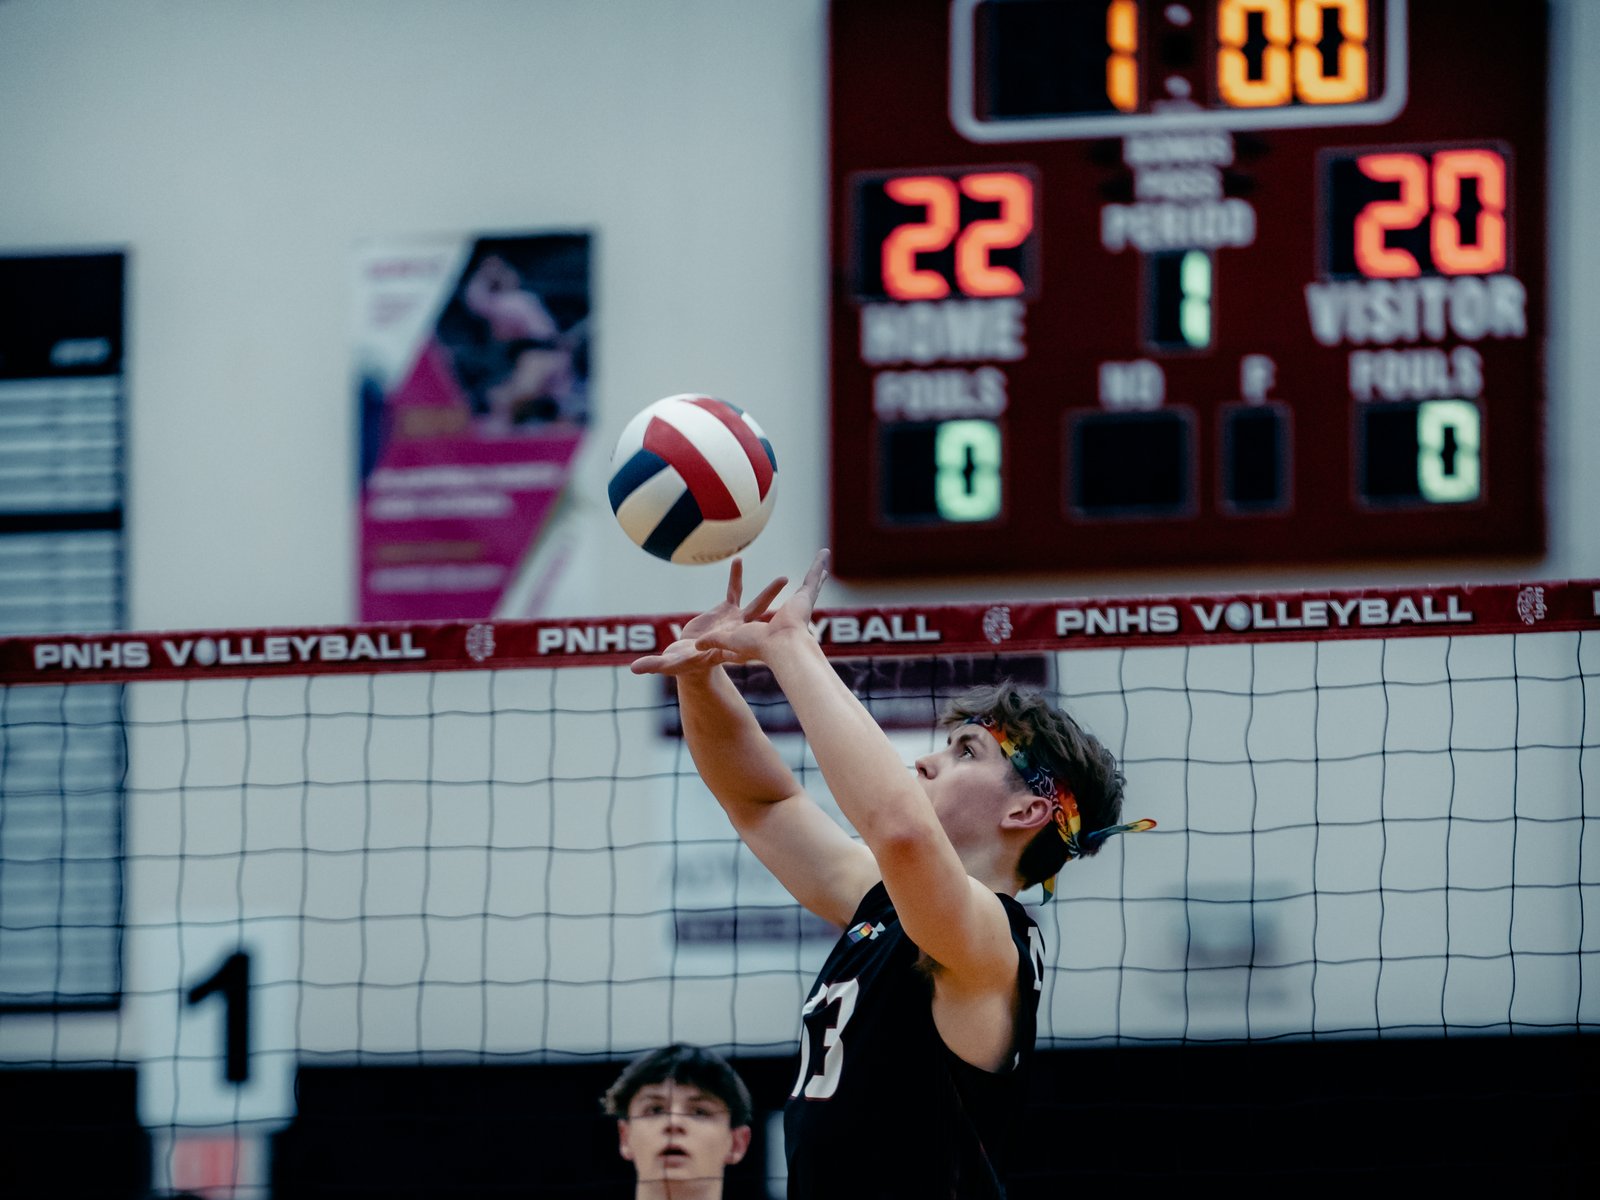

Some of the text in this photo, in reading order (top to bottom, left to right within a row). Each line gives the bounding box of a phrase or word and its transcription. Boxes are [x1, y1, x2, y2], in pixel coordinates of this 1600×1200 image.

[1106, 0, 1369, 111] 1:00
[882, 172, 1034, 300] 22
[1101, 198, 1257, 253] PERIOD
[1353, 148, 1507, 279] 20
[860, 299, 1028, 367] HOME
[1180, 250, 1211, 349] 1
[1304, 275, 1528, 347] VISITOR
[873, 366, 1008, 422] FOULS
[1349, 345, 1484, 402] FOULS
[935, 419, 1001, 522] 0
[1416, 400, 1481, 502] 0
[34, 632, 426, 670] PNHS VOLLEYBALL
[536, 624, 657, 655] PNHS
[1056, 594, 1472, 636] PNHS VOLLEYBALL
[187, 950, 251, 1086] 1
